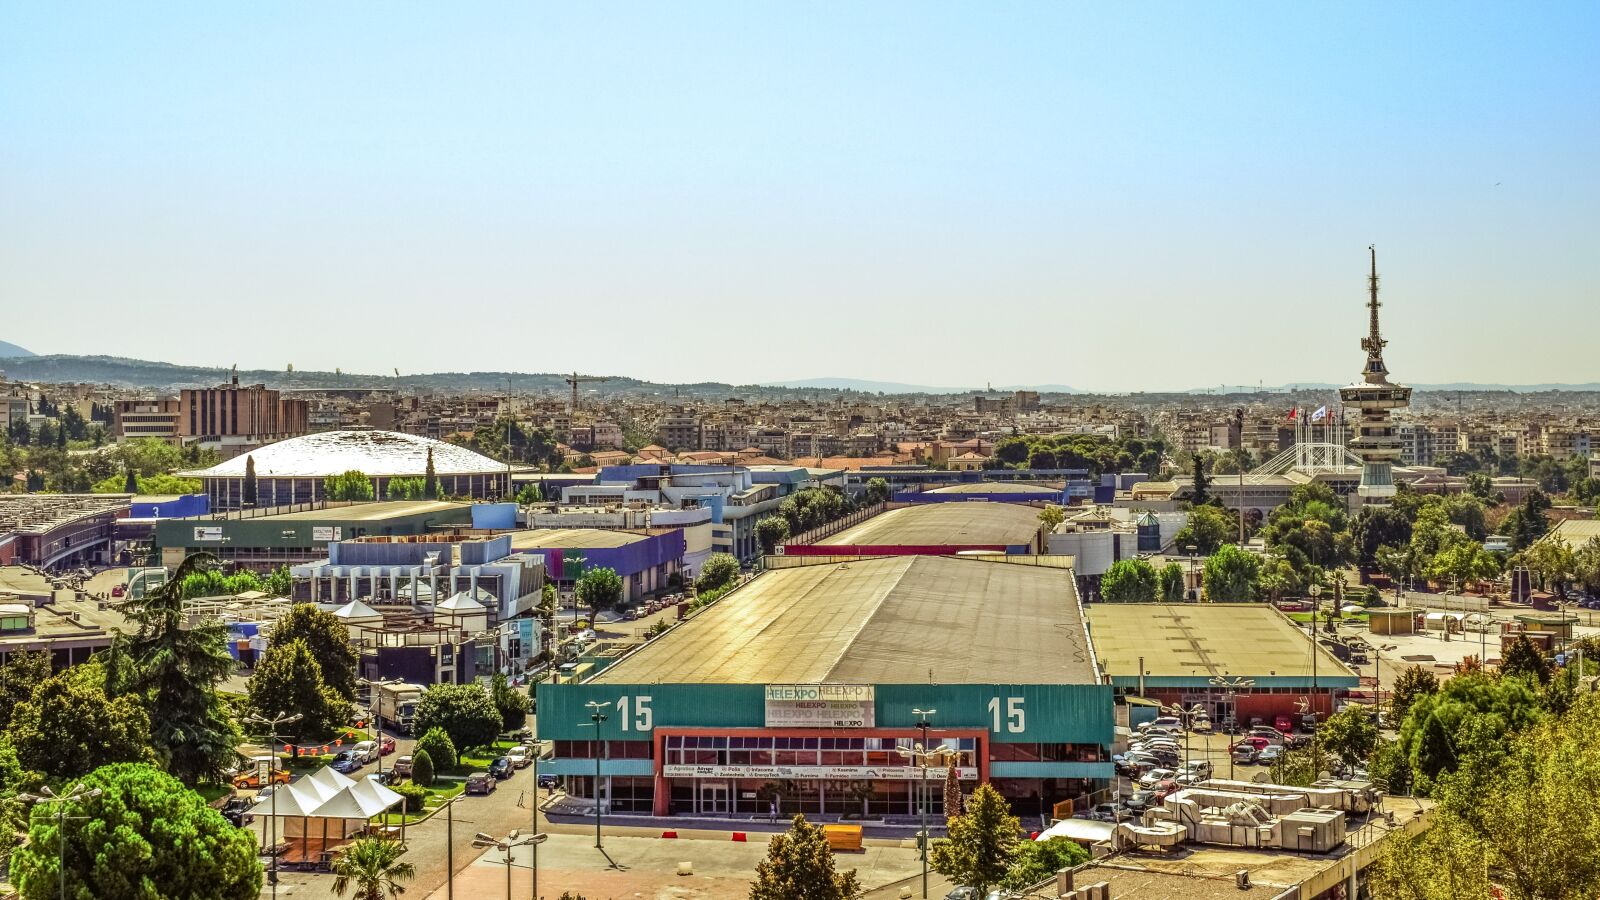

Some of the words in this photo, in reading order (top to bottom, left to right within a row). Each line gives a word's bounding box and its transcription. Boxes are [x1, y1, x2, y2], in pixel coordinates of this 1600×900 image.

[152, 506, 159, 518] 3
[767, 689, 817, 699] HELEXPO
[819, 687, 863, 696] HELEXPO
[617, 696, 652, 731] 15
[768, 709, 813, 718] HELEXPO
[817, 710, 860, 719] HELEXPO
[988, 697, 1025, 733] 15
